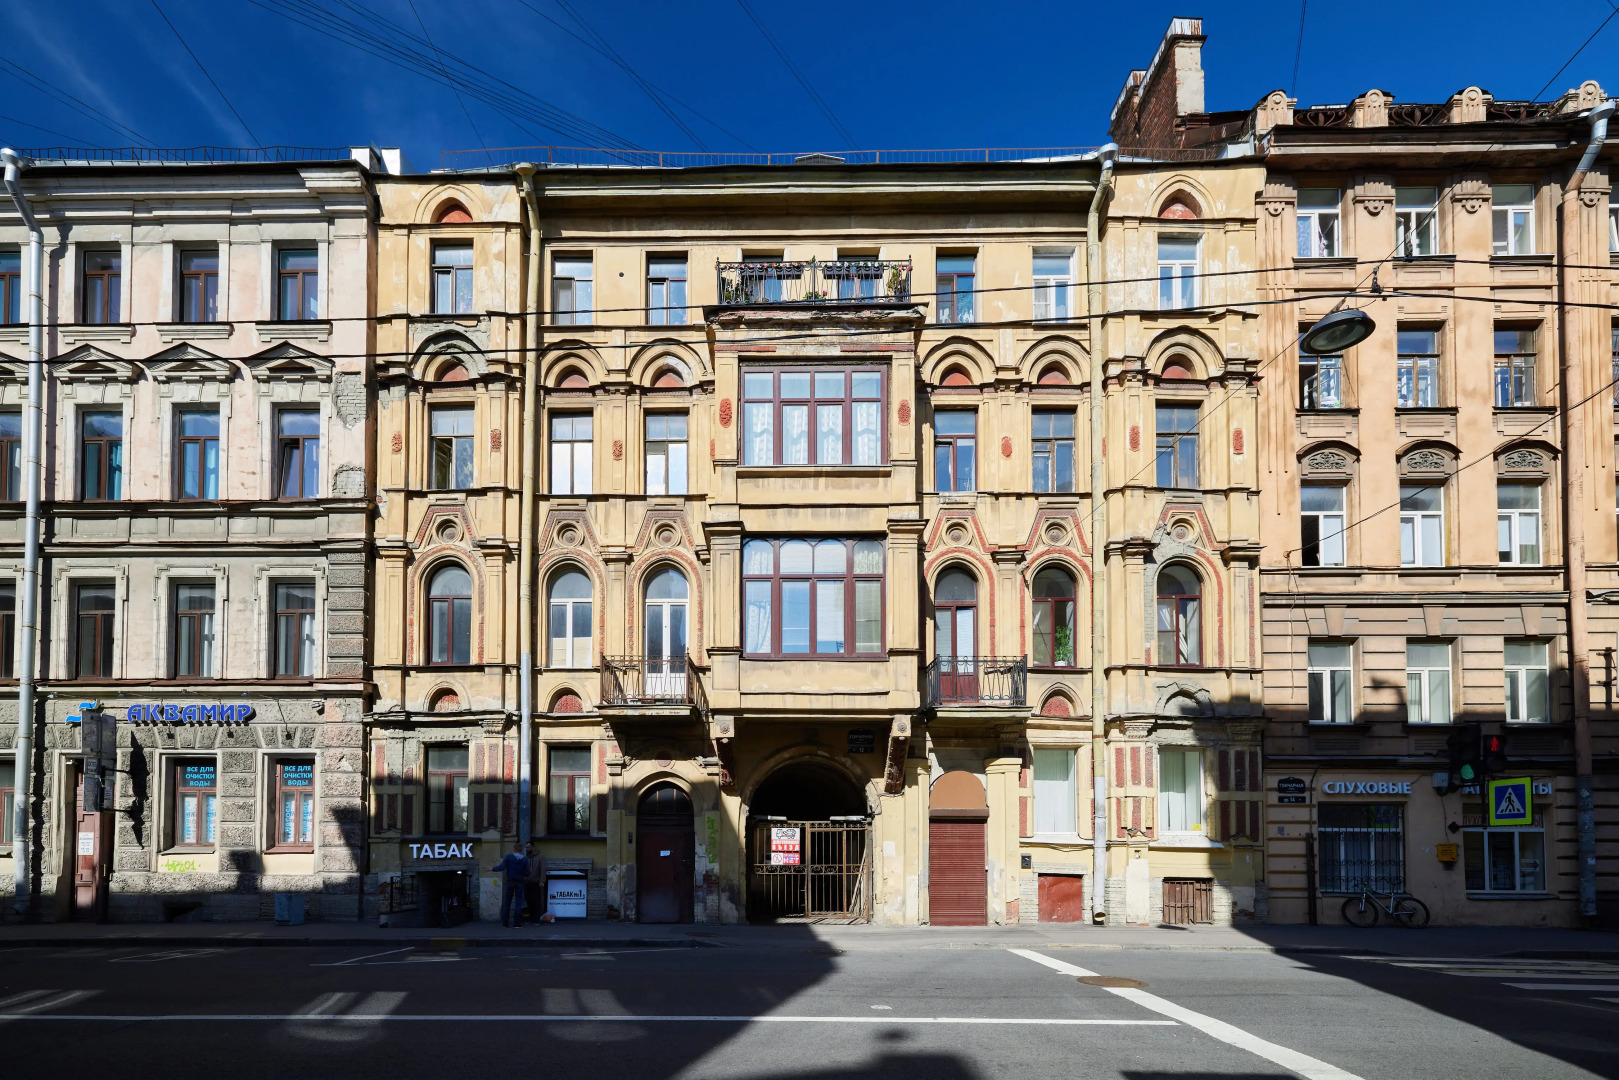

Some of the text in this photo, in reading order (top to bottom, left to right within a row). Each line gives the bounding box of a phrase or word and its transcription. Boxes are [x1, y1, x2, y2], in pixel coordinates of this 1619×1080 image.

[127, 704, 251, 722] АКВАМИР
[297, 765, 312, 773] ДЛЯ
[189, 780, 211, 788] ВОДЫ
[287, 779, 309, 787] ВОДЫ
[1324, 781, 1412, 794] СЛУХОВЫЕ
[408, 842, 474, 859] ТАБАК
